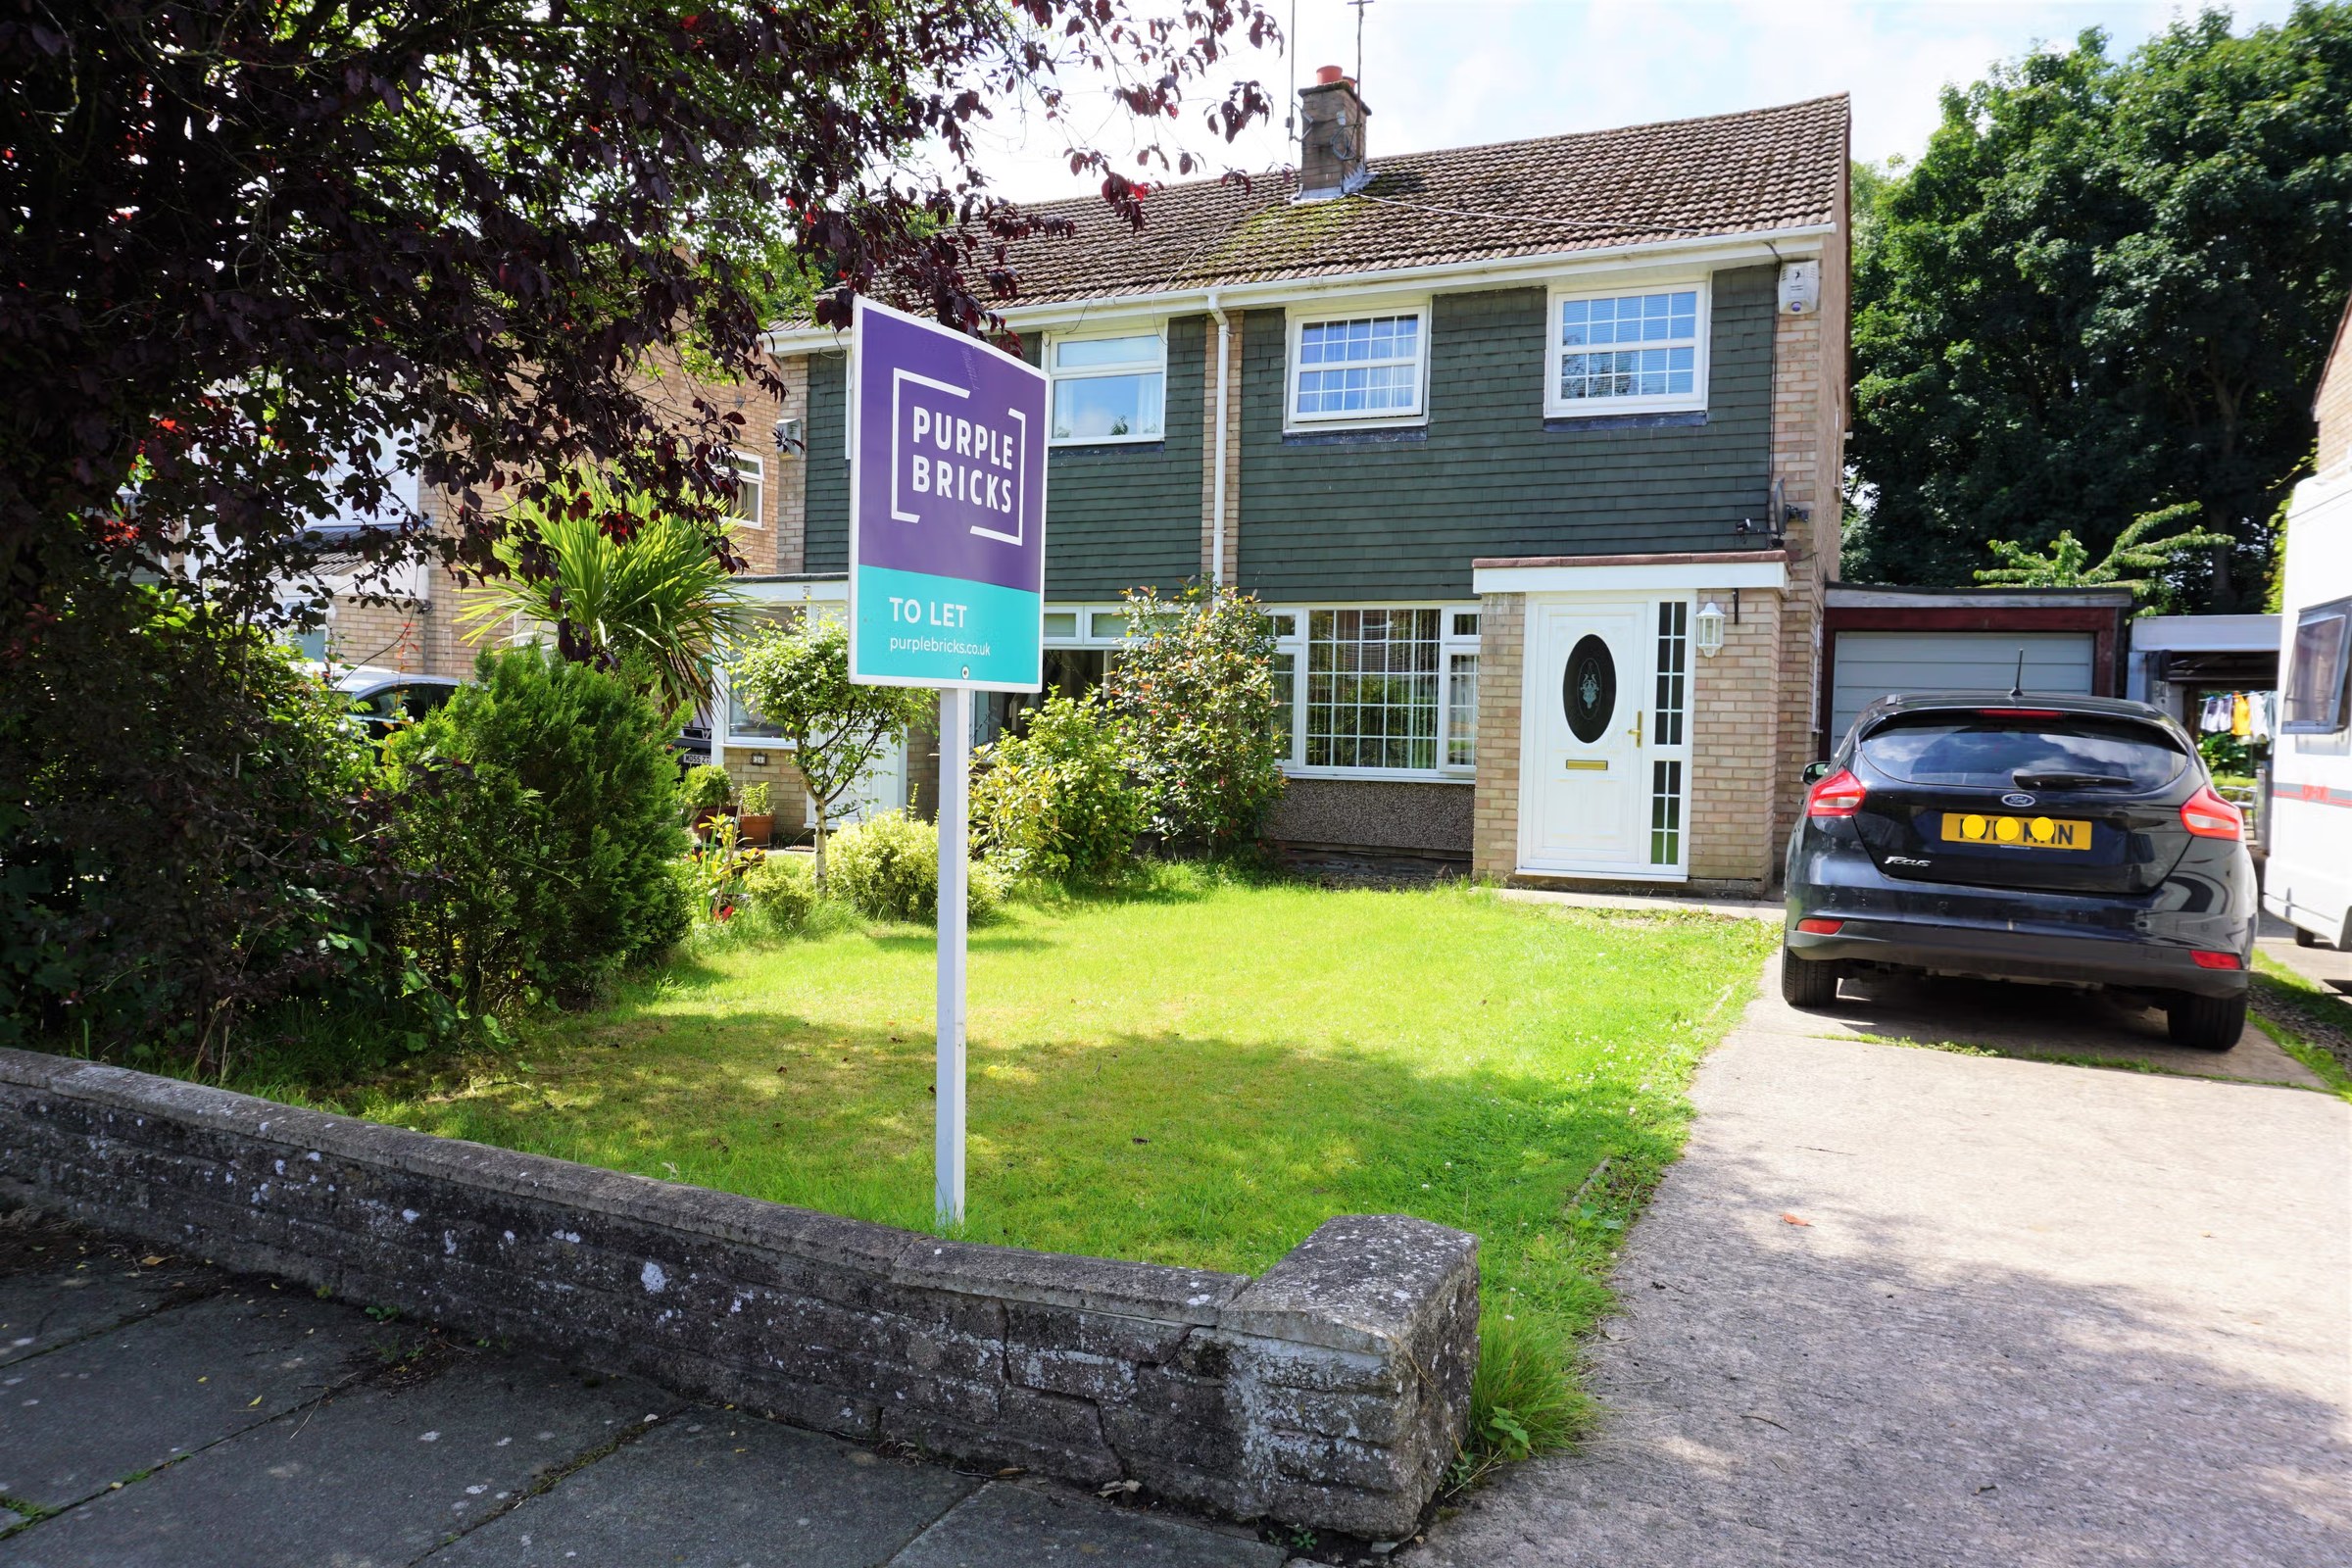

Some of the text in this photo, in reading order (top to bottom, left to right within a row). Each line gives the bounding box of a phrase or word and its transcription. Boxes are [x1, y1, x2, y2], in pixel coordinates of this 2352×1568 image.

[913, 406, 1013, 470] PURPLE
[912, 454, 1011, 514] BRICKS
[889, 597, 967, 627] TO LET
[890, 636, 991, 656] purplebricks.co.uk
